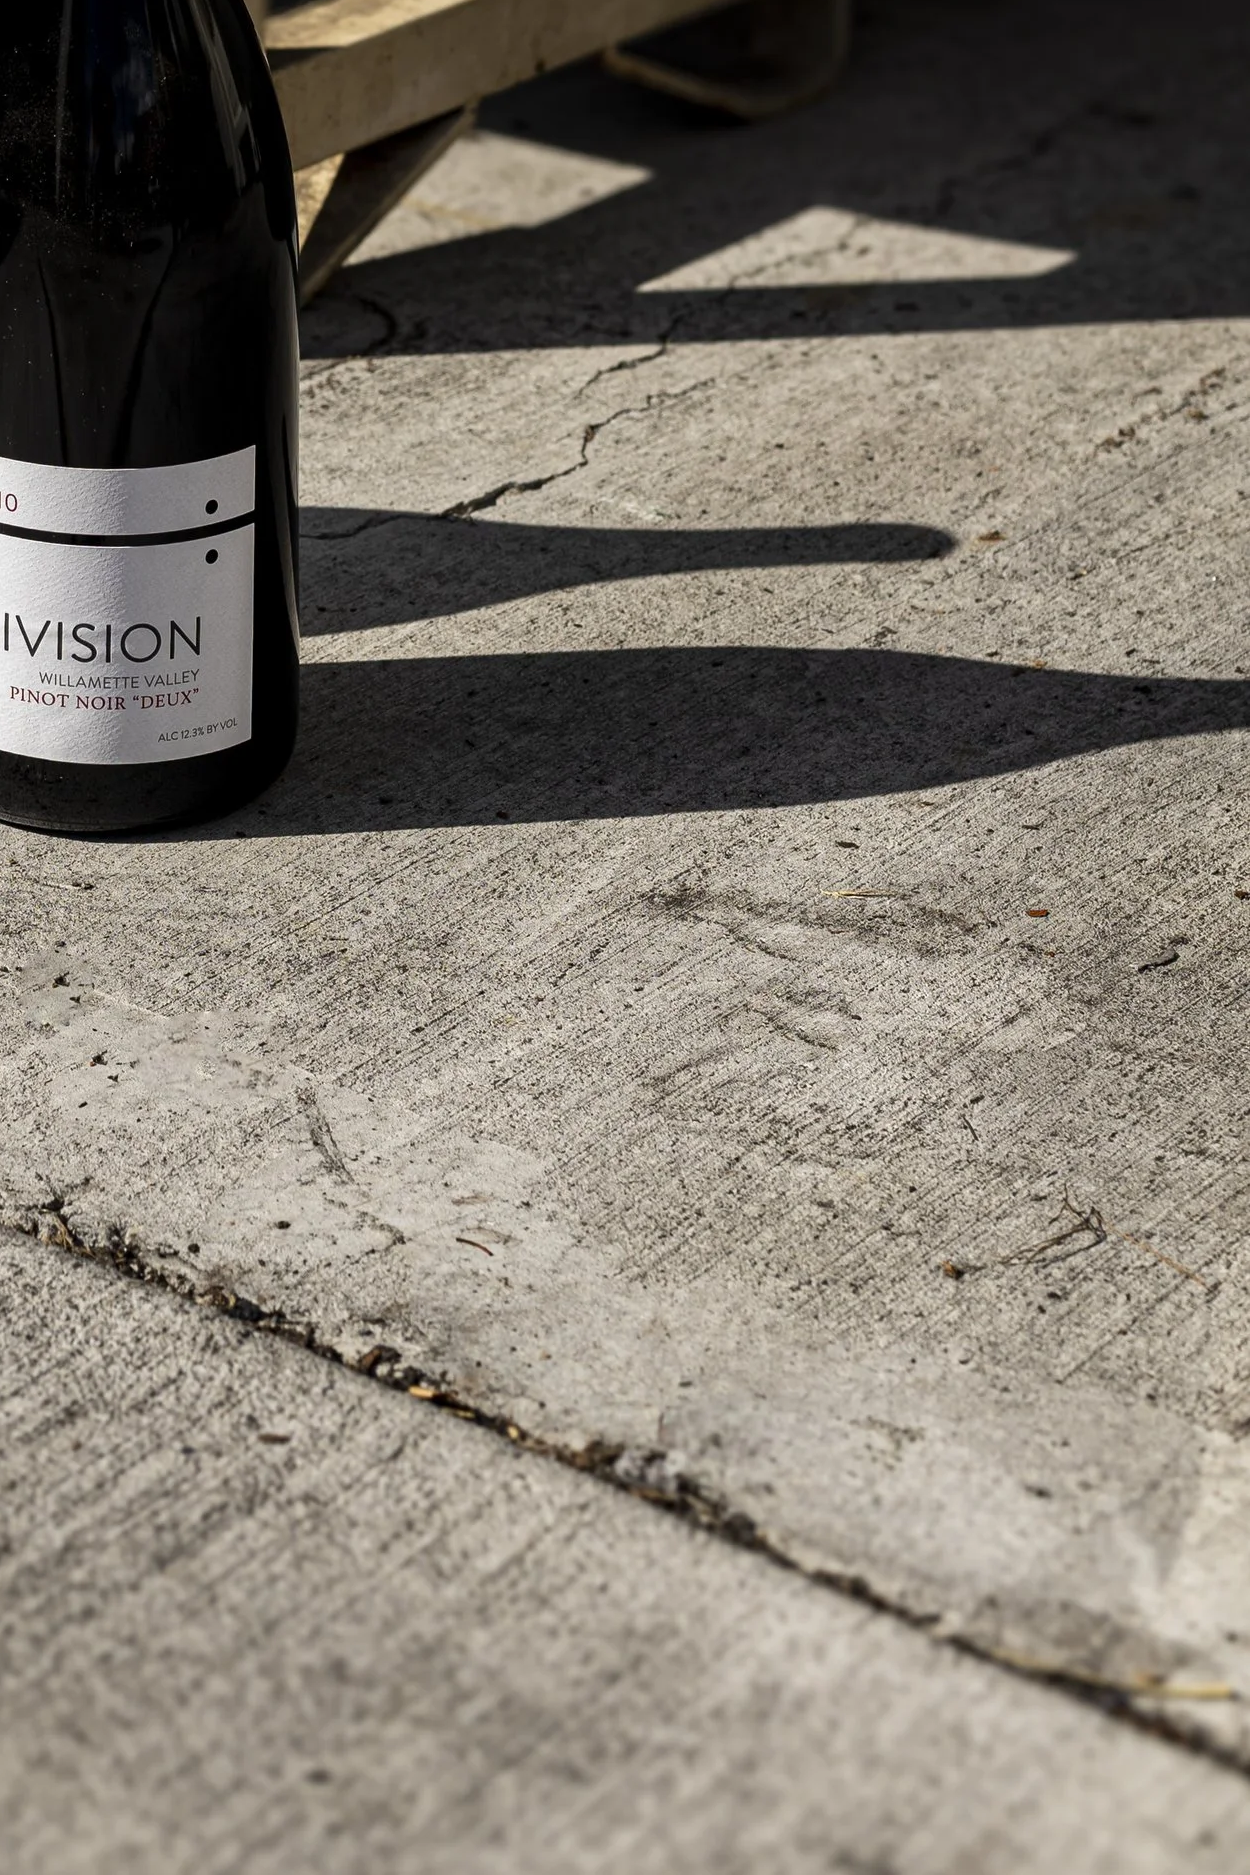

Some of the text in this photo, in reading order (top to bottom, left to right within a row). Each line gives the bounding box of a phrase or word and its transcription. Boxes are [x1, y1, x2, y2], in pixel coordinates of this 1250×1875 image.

[39, 668, 200, 689] WILLAMETTE VALLEY
[9, 685, 70, 708] PINOT
[76, 695, 127, 711] NOIR
[157, 717, 238, 743] ALC 12.3% BY VOL
